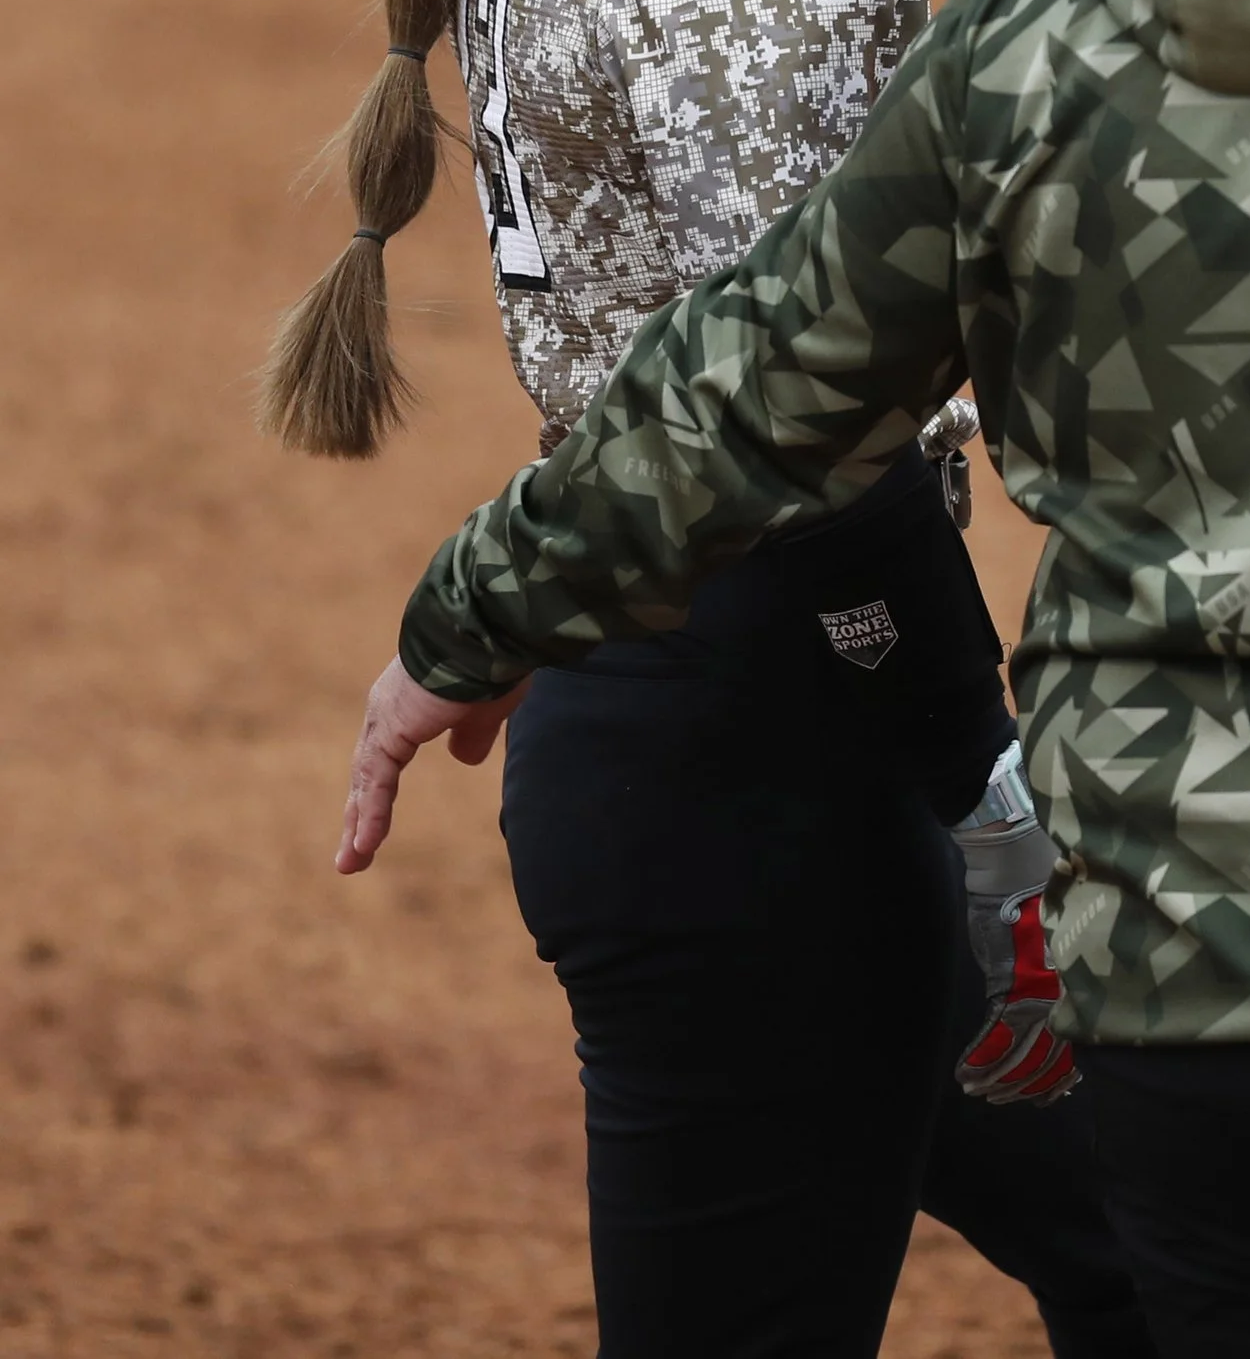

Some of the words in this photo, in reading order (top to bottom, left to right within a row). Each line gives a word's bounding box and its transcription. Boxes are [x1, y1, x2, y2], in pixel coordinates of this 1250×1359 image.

[1200, 393, 1237, 431] USA
[1214, 582, 1250, 617] USA
[822, 614, 850, 626] OWN
[852, 604, 884, 620] THE
[827, 613, 890, 640] ZONE
[834, 628, 894, 651] SPORTS
